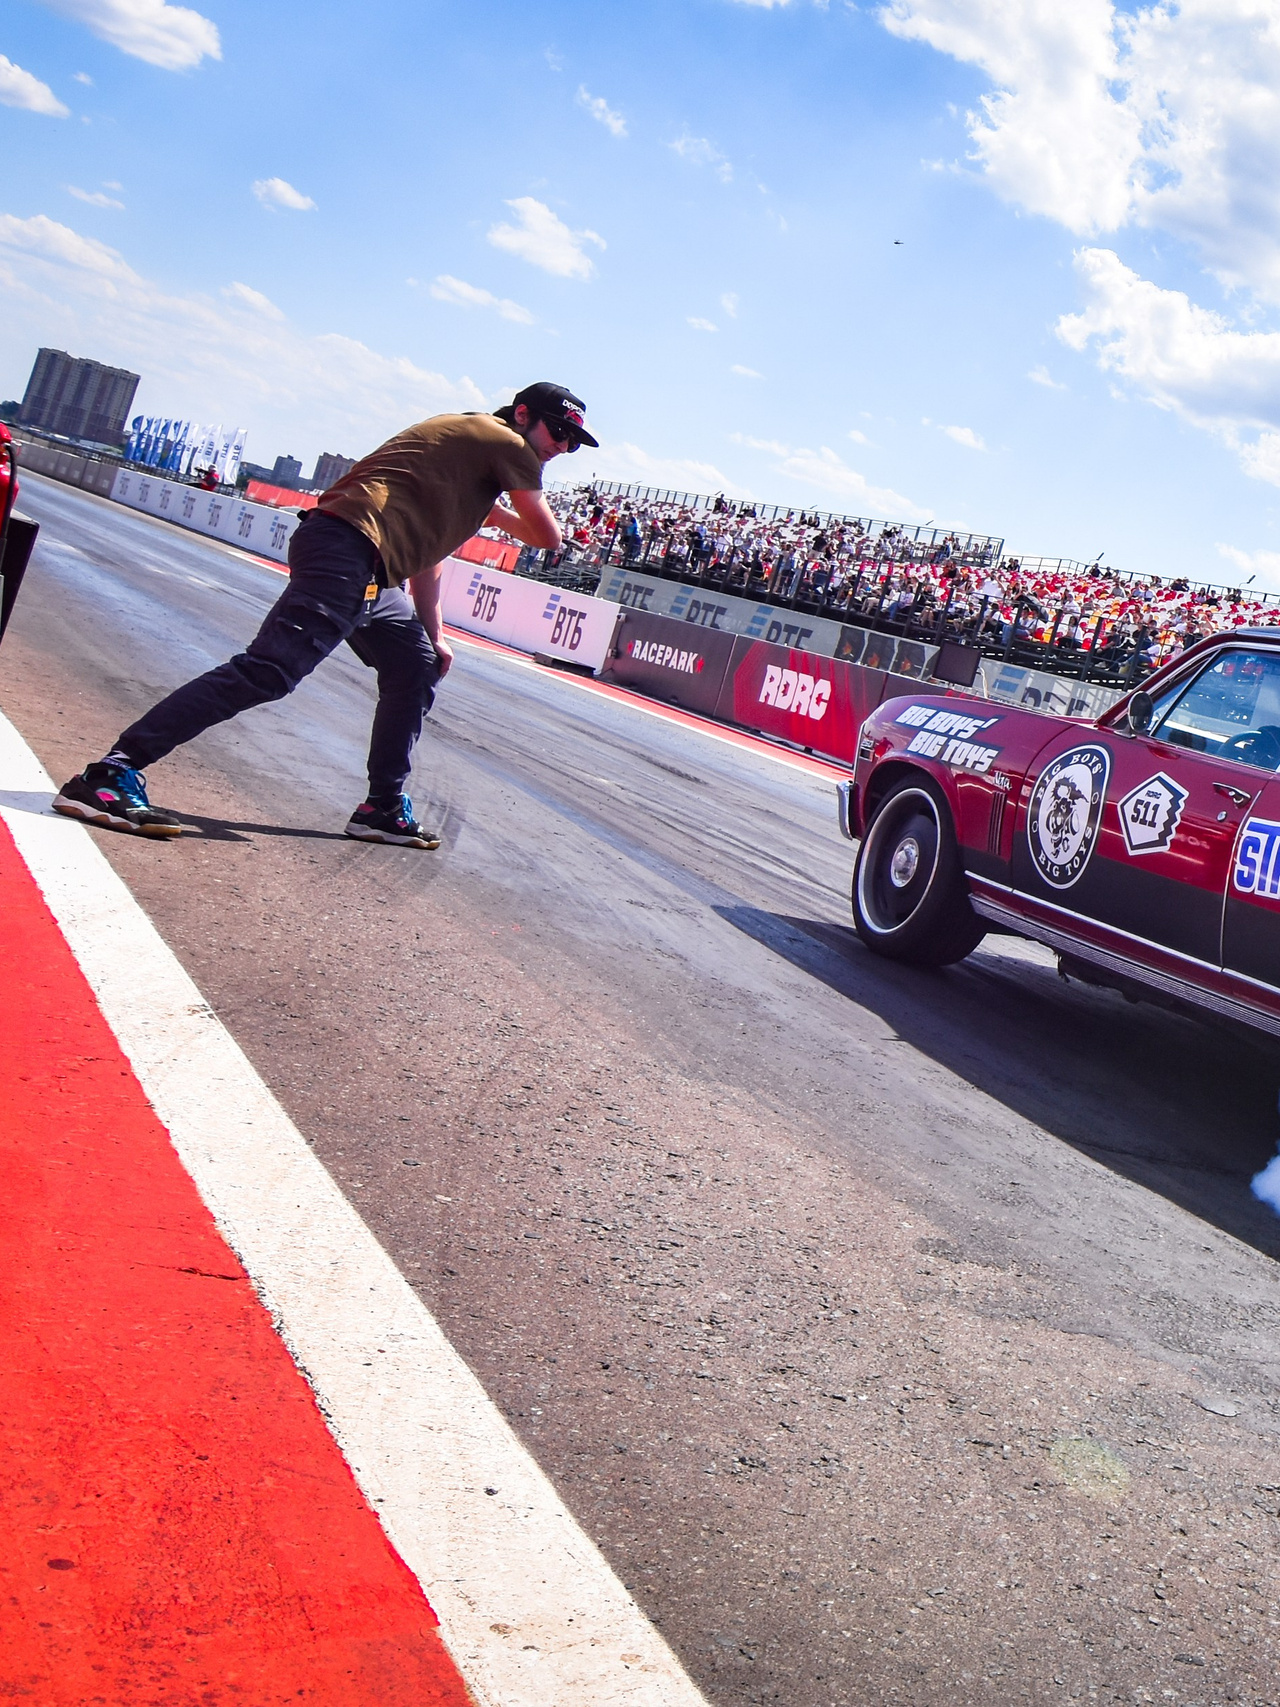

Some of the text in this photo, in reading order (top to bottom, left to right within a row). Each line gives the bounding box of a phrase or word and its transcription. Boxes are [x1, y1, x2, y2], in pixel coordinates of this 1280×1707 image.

[472, 583, 502, 622] ВТБ
[550, 606, 587, 650] ВТБ
[632, 639, 699, 673] RACEPARK
[759, 664, 832, 720] RDRC
[895, 705, 938, 727] BIG
[907, 730, 999, 772] BIG TOYS
[1036, 763, 1062, 799] BIG
[1131, 798, 1160, 828] 511
[1038, 826, 1093, 877] BIG TOYS
